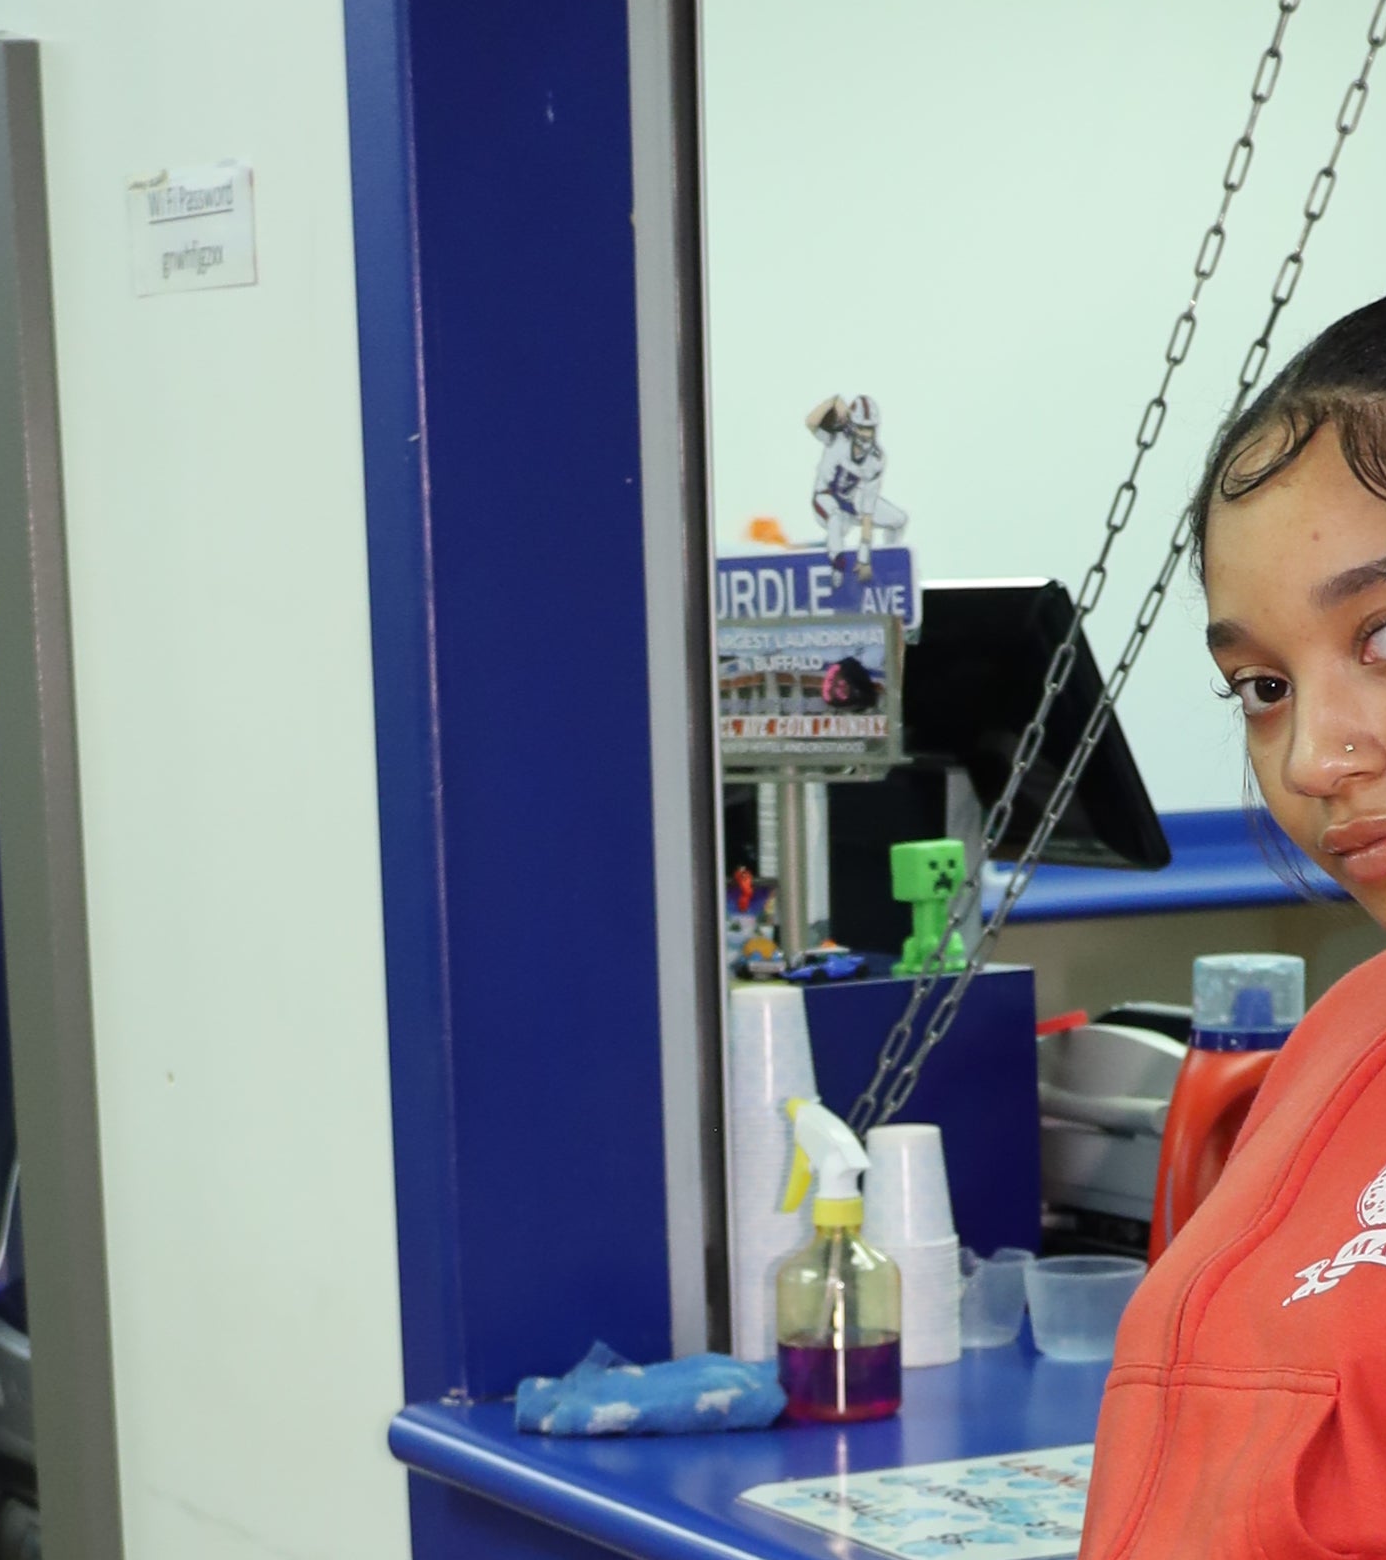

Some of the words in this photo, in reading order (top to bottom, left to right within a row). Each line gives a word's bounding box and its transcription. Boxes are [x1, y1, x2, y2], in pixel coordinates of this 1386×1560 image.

[178, 178, 233, 214] Password
[861, 585, 906, 616] AVE
[774, 627, 885, 649] LAUNDROMAT
[754, 654, 824, 672] BUFFALO
[776, 716, 813, 737] COIN
[819, 716, 889, 737] LAUNDRY
